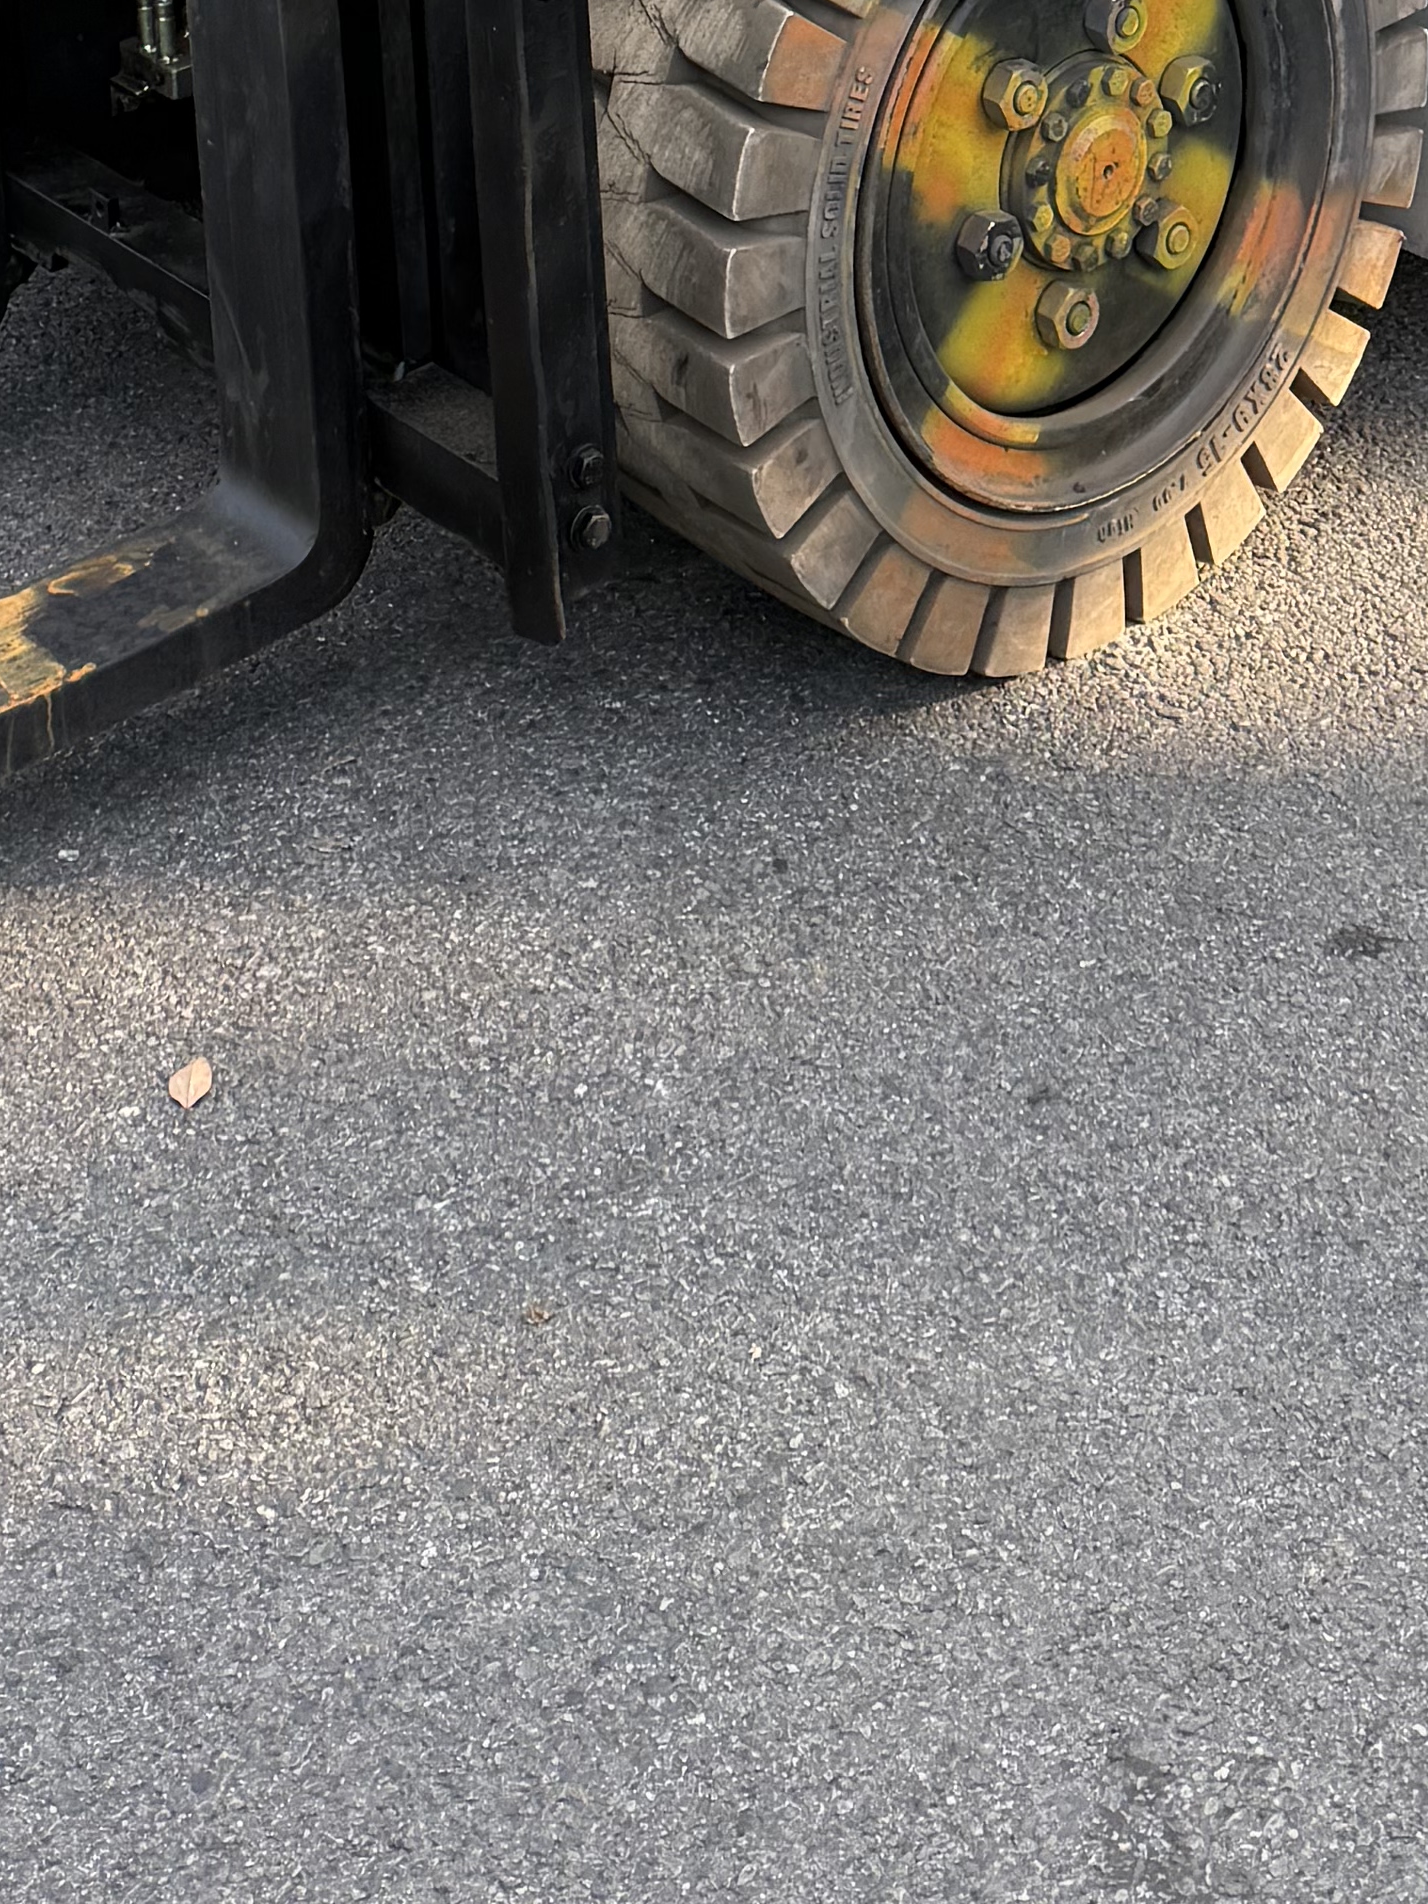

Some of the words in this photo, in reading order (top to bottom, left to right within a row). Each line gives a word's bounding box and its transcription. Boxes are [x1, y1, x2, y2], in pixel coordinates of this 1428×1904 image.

[835, 66, 875, 145] TIRES
[820, 156, 849, 240] SOLID
[818, 246, 854, 405] INDUSTRIAL
